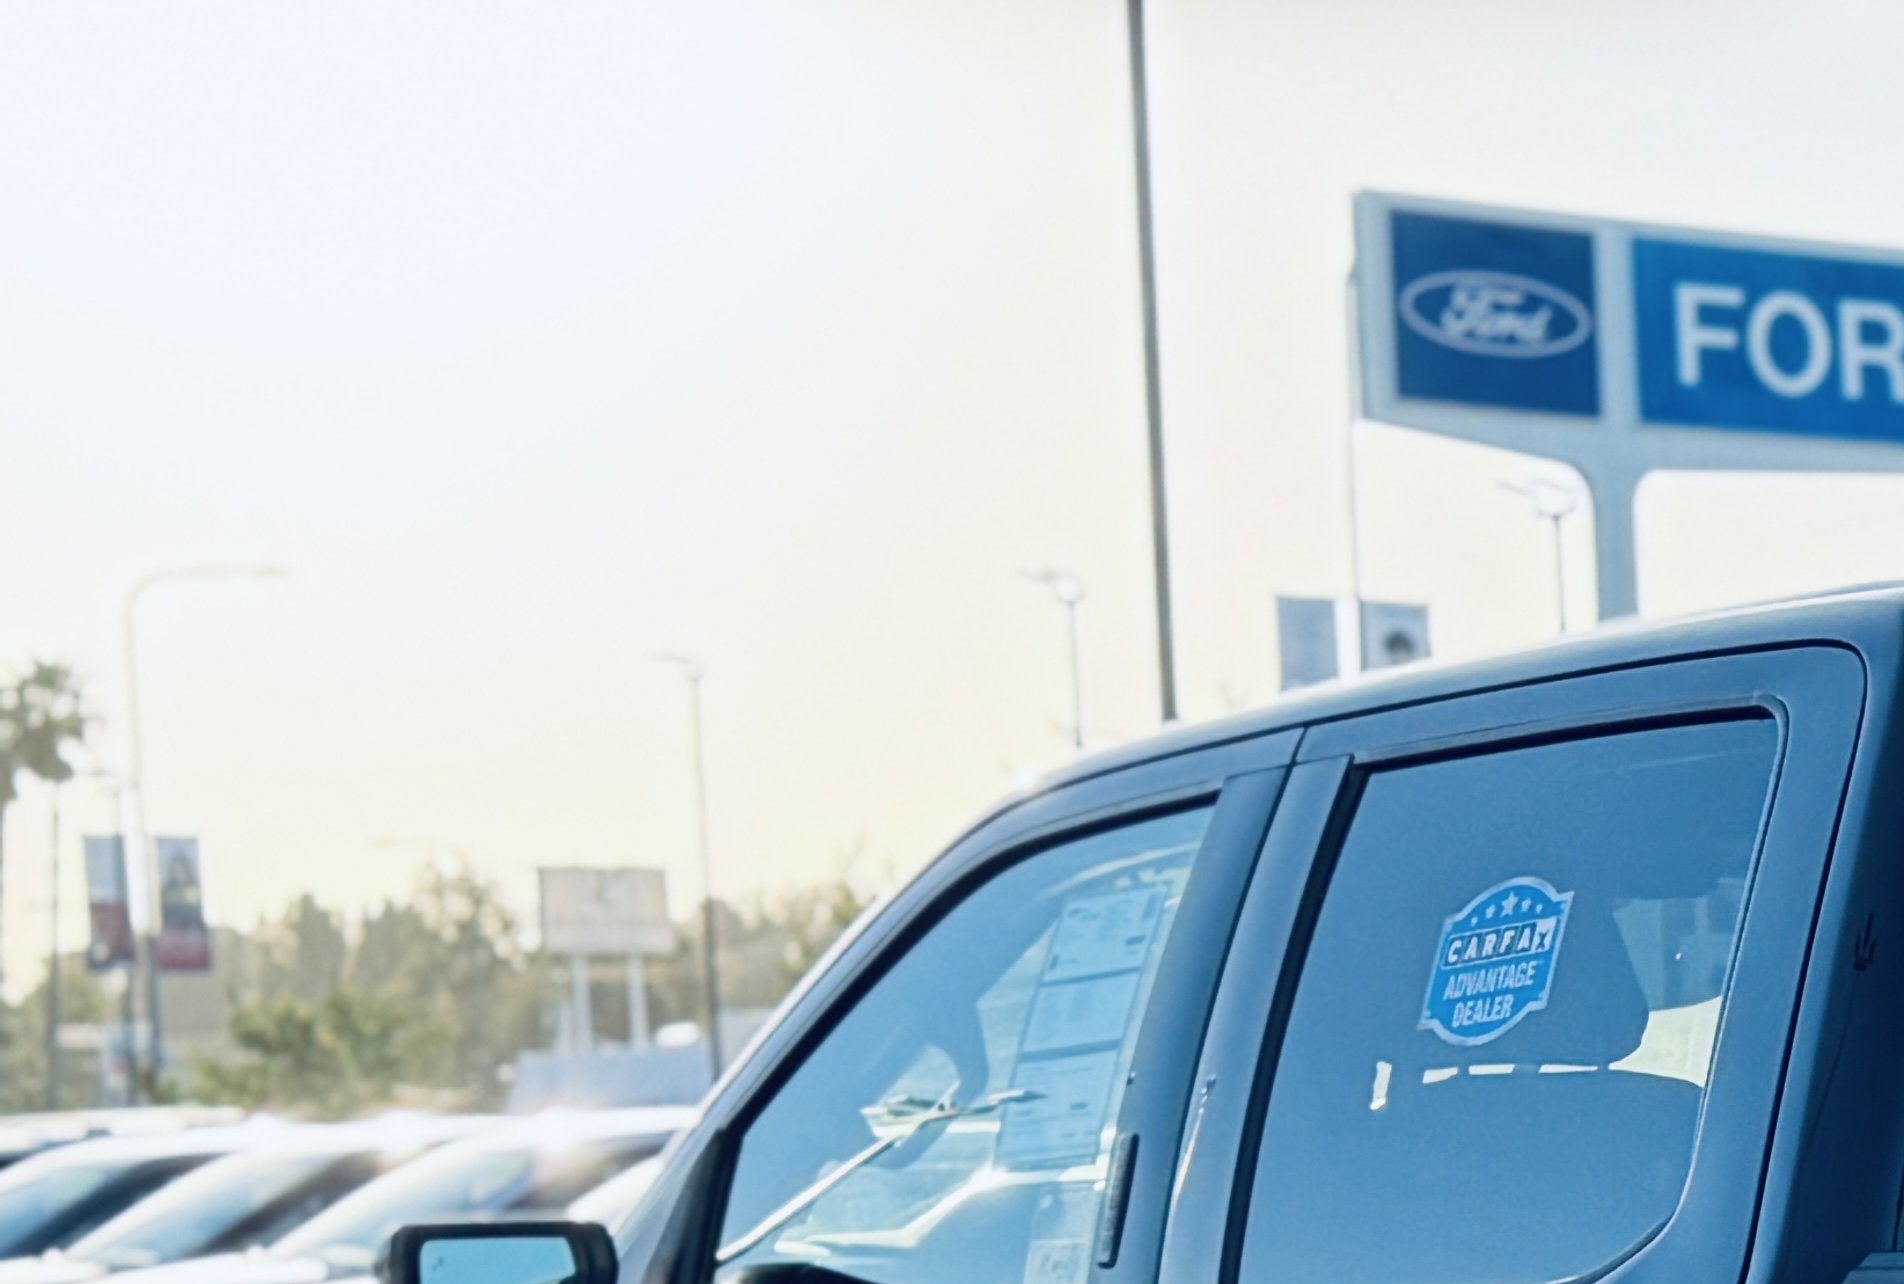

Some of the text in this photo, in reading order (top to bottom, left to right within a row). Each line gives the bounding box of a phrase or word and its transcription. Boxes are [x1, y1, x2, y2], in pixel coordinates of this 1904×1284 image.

[1440, 284, 1553, 345] Ford
[1446, 926, 1551, 965] CARFAX
[1443, 961, 1538, 1000] ADVANTAGE
[1451, 994, 1515, 1028] DEALER
